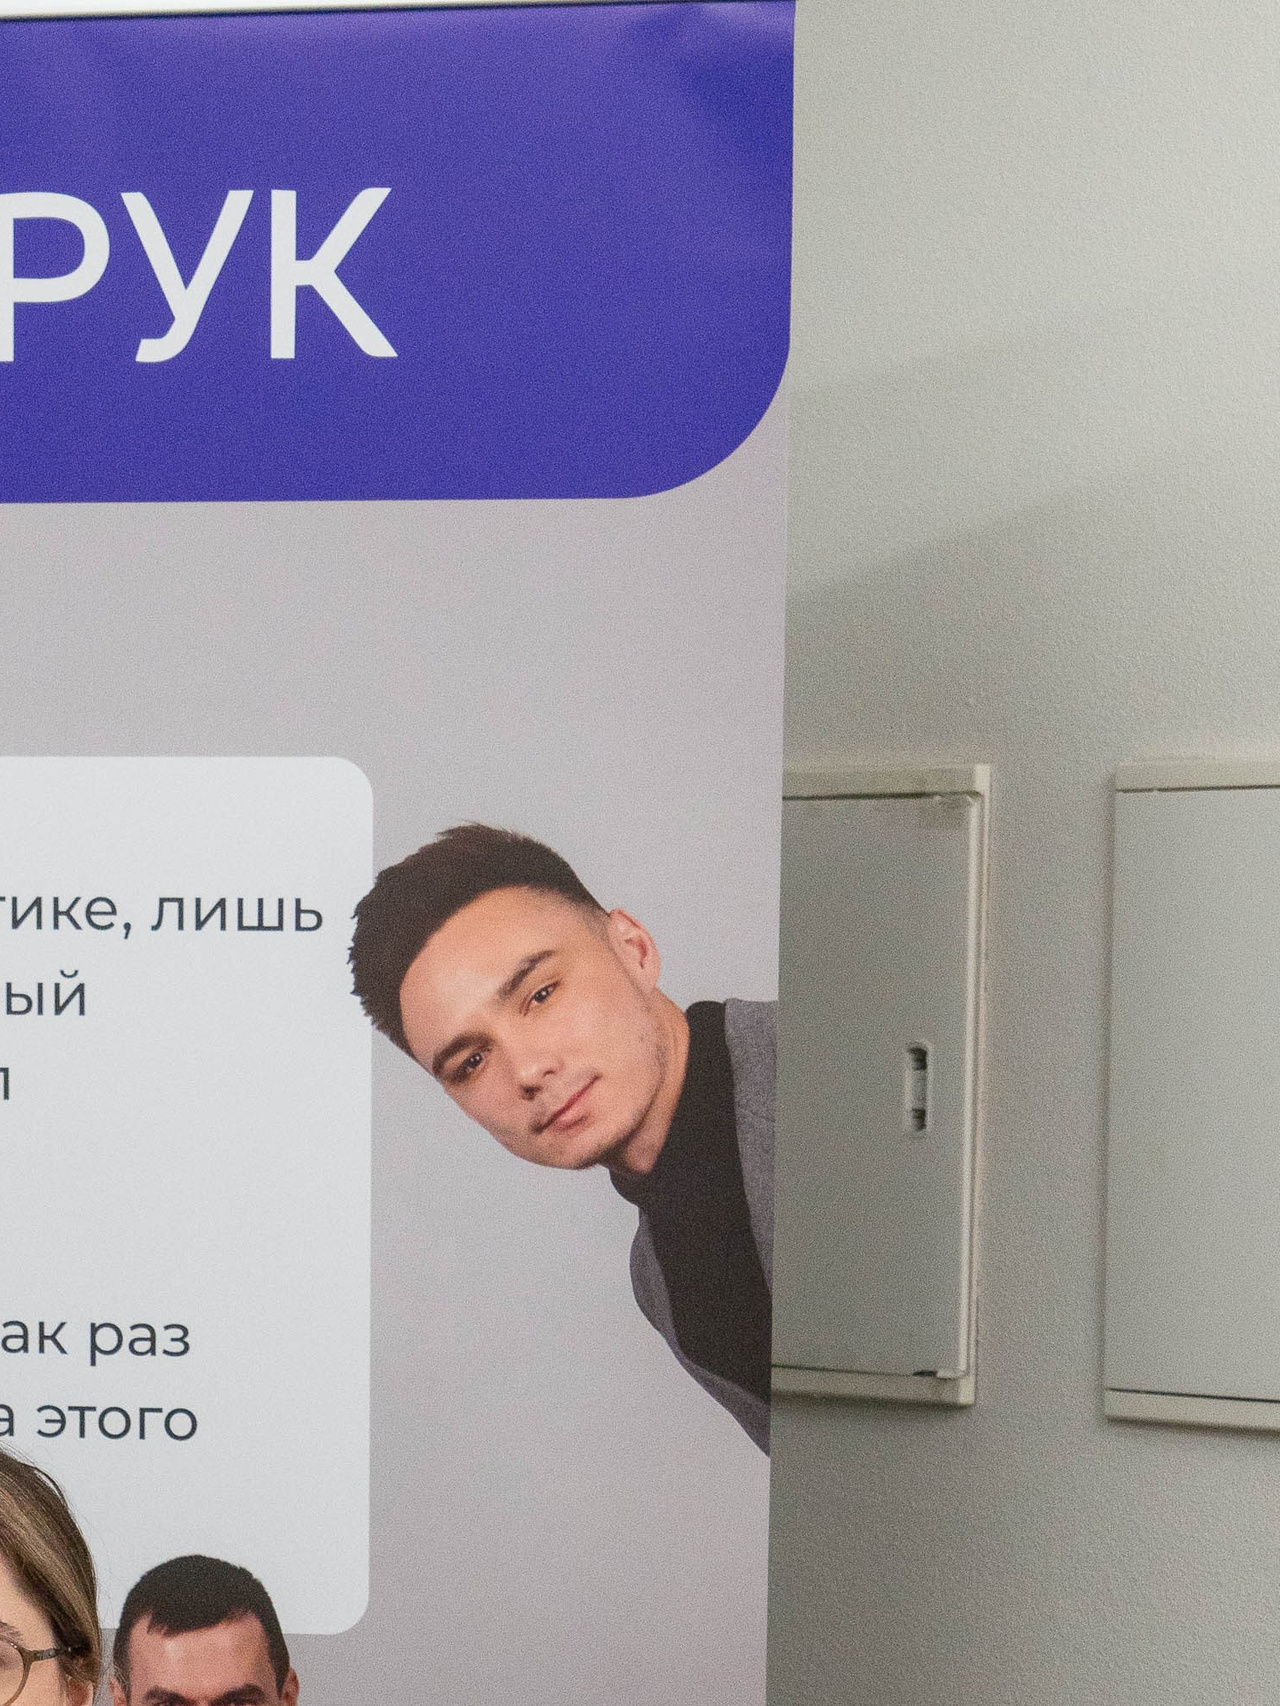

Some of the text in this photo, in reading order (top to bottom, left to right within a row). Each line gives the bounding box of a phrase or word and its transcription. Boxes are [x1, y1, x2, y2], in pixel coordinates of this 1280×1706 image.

[151, 897, 324, 932] лишь
[89, 1322, 191, 1367] раз
[36, 1404, 198, 1442] этого
